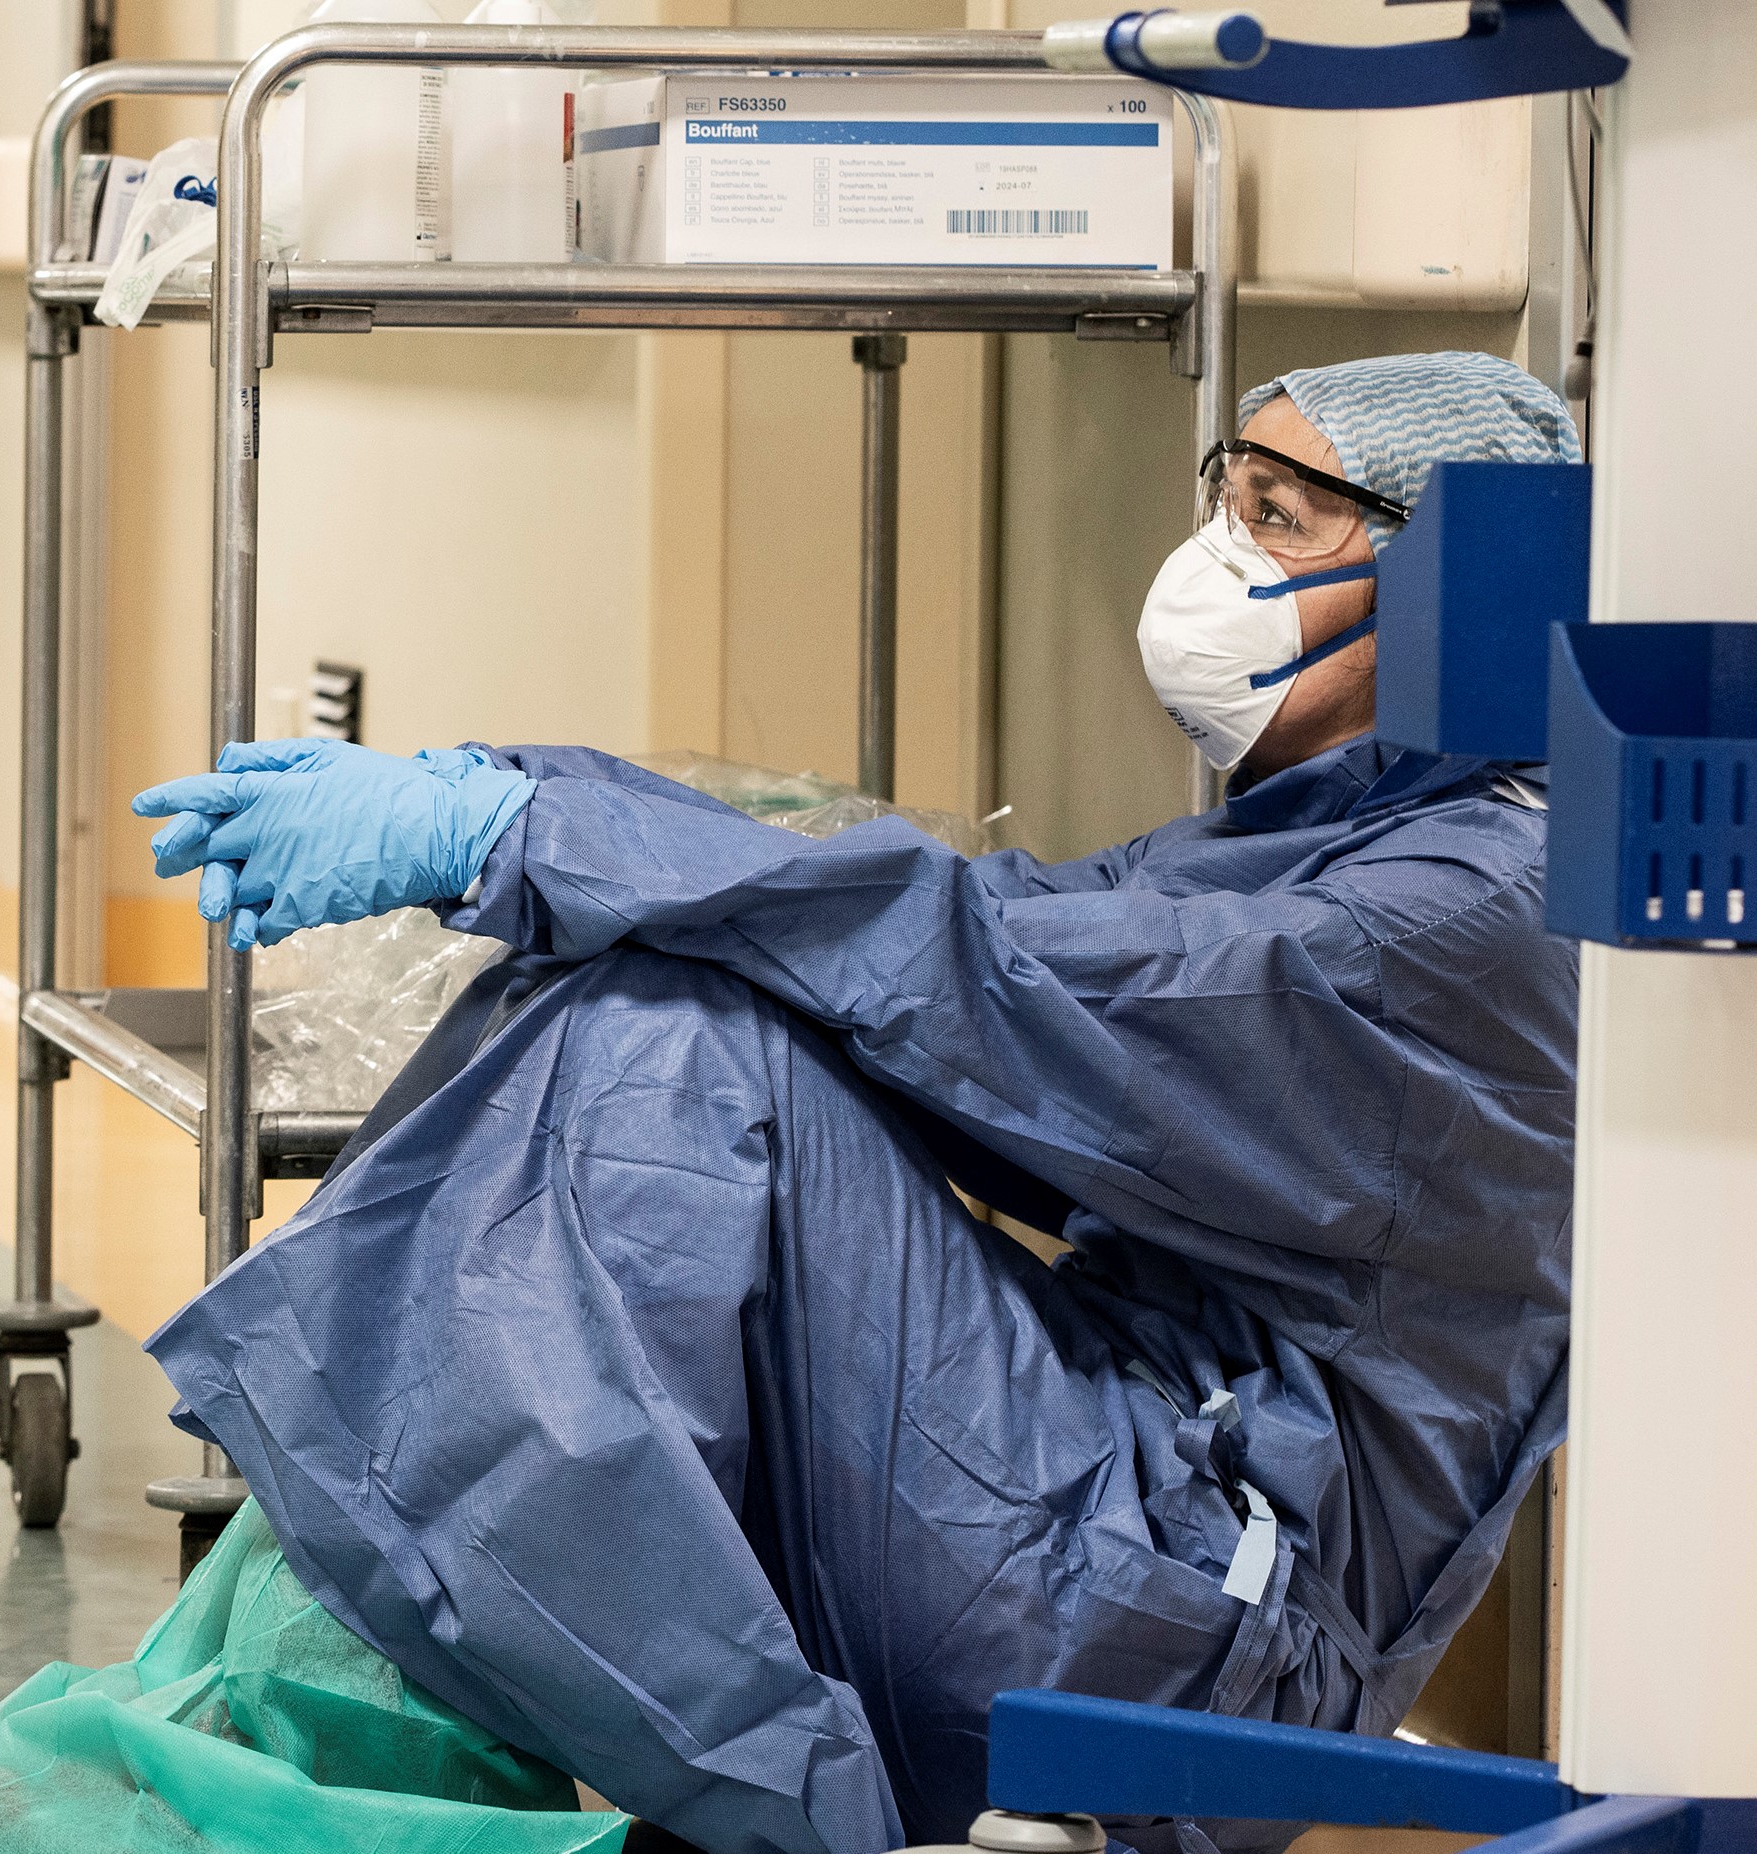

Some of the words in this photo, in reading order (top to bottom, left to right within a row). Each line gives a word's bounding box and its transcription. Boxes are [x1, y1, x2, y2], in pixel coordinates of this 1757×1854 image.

[718, 97, 787, 111] FS63350
[1107, 104, 1114, 113] x
[1120, 100, 1147, 113] 100
[688, 122, 759, 138] Bouffant
[996, 181, 1032, 190] 2024-07
